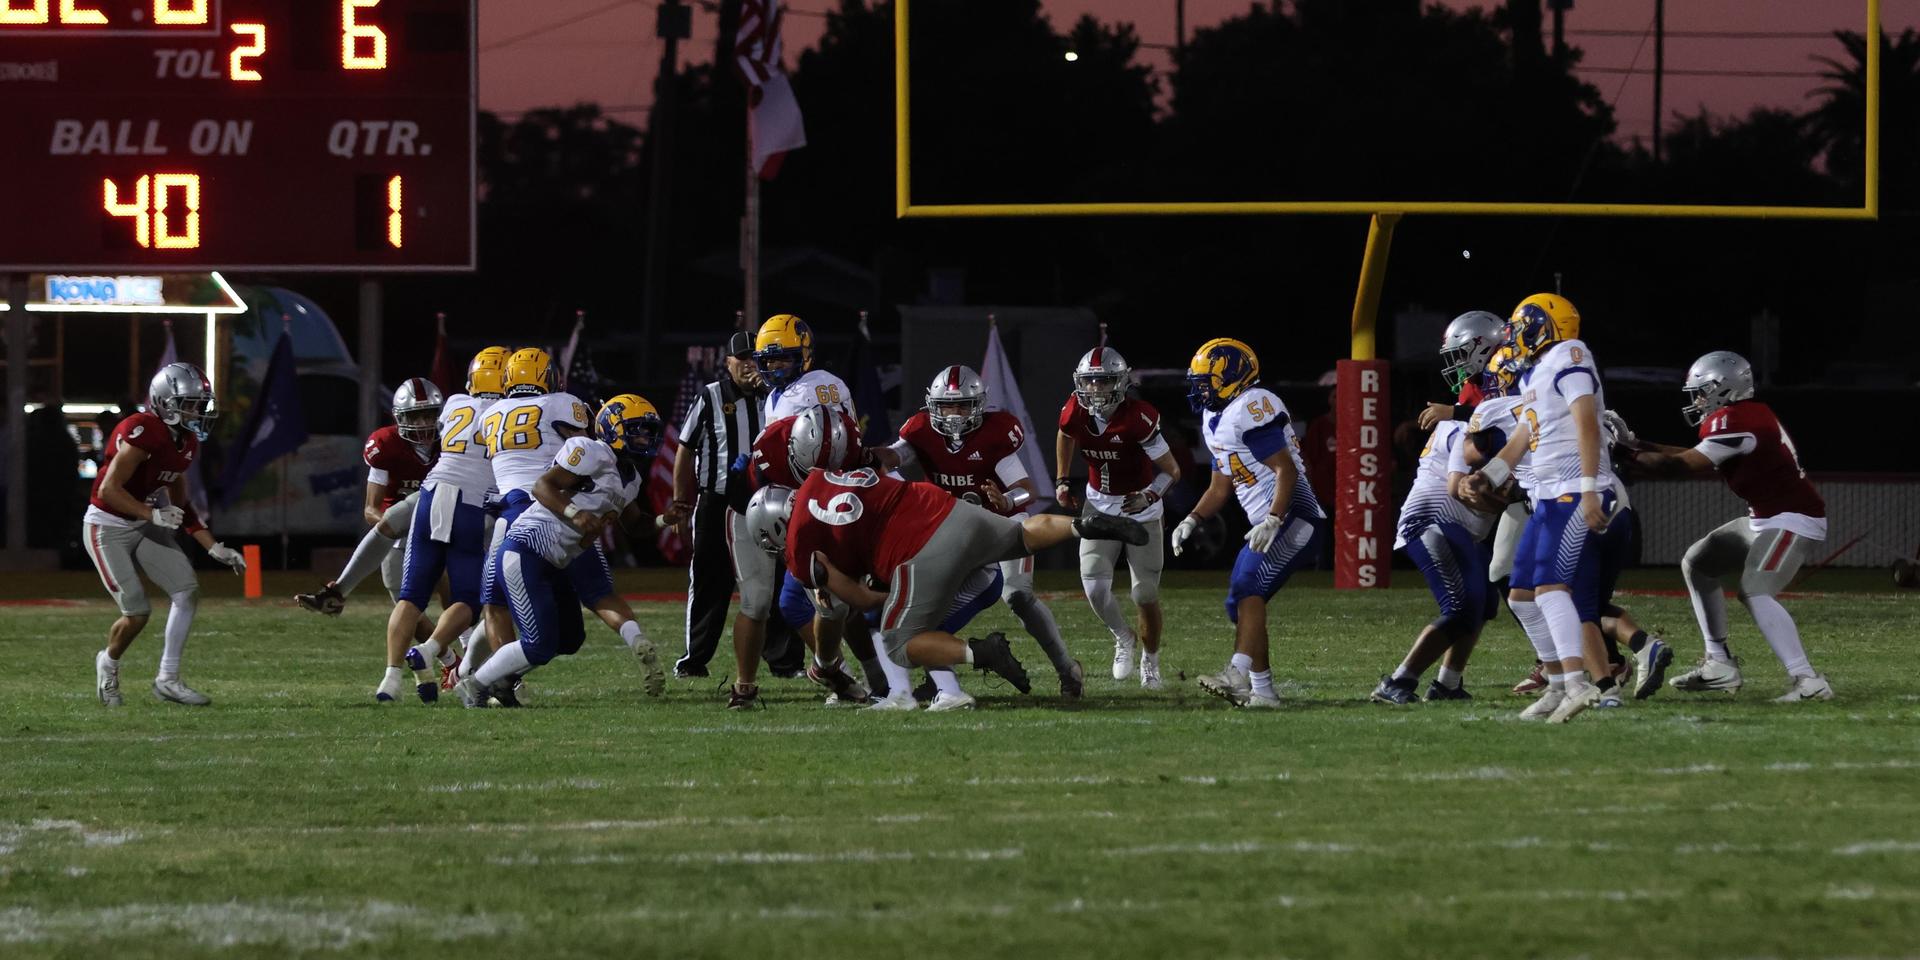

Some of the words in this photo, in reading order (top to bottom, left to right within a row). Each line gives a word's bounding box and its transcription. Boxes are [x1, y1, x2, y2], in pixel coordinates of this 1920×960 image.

[154, 50, 222, 80] TOL
[230, 23, 266, 81] 2
[50, 120, 169, 155] BALL
[189, 120, 254, 155] ON
[328, 120, 432, 158] QTR.
[104, 174, 200, 249] 40
[388, 175, 402, 249] 1
[815, 384, 840, 405] 66
[1247, 396, 1276, 422] 54
[1710, 414, 1728, 433] 11
[567, 447, 586, 467] 6
[1082, 448, 1121, 460] TRIBE
[933, 474, 976, 486] TRIBE
[1358, 369, 1380, 588] REDSKINS
